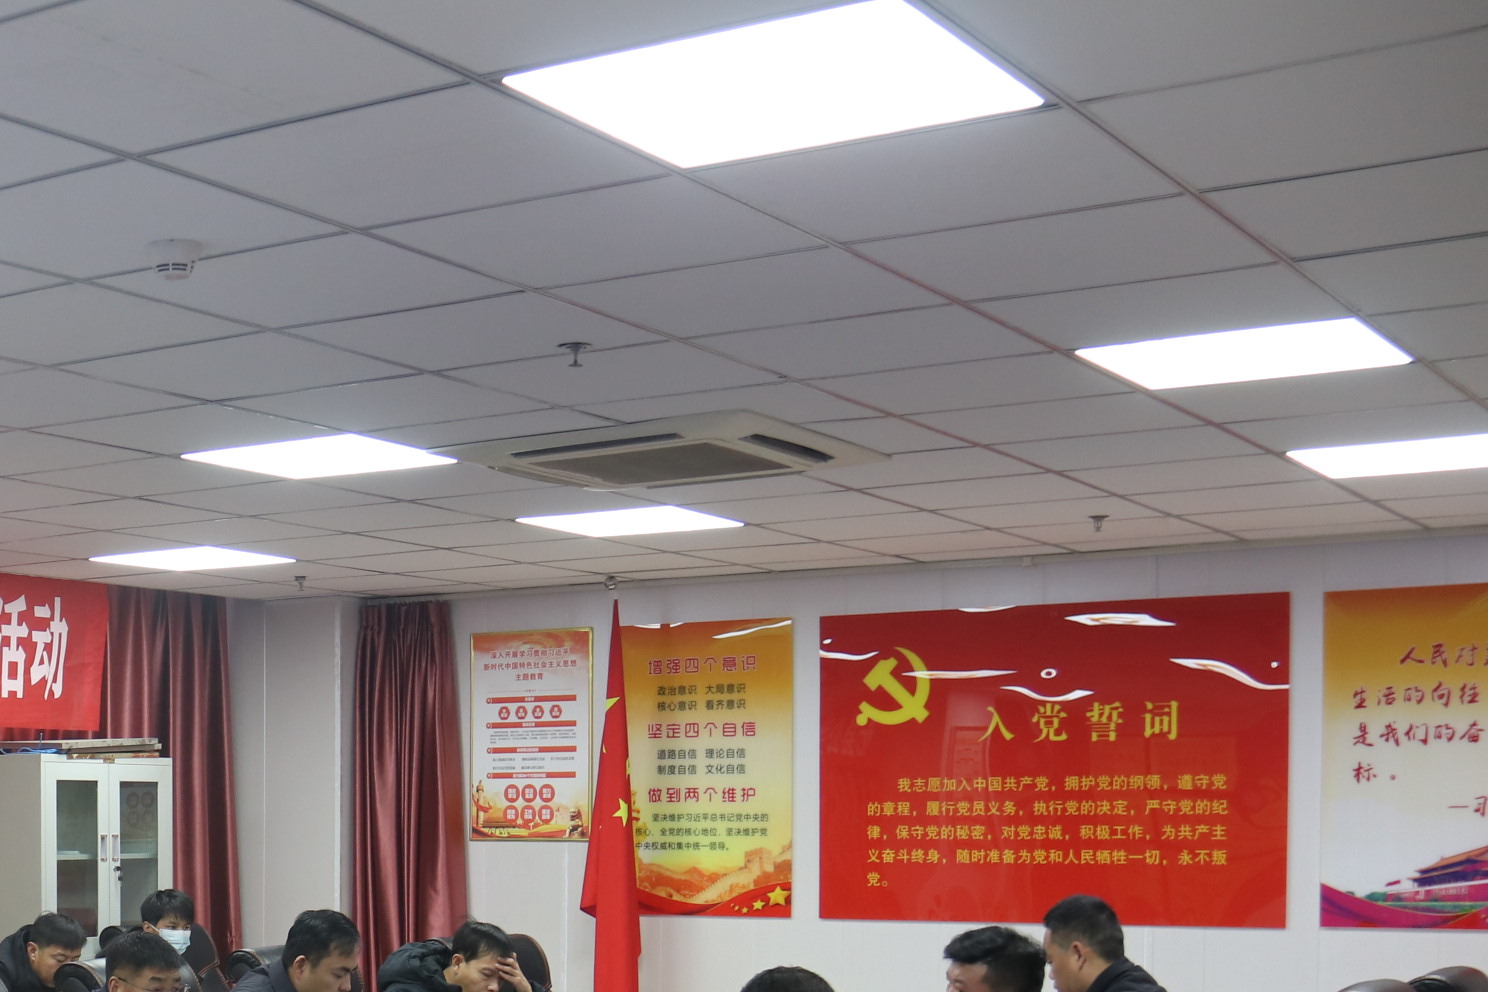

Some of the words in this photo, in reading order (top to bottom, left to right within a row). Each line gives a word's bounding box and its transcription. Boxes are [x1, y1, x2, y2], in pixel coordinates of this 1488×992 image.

[1399, 643, 1488, 668] 人民对
[647, 655, 757, 675] 增强四个意识
[656, 684, 697, 696] 政治意识
[704, 683, 746, 695] 大局意识
[1352, 681, 1480, 709] 生活的向往
[656, 700, 697, 712] 核心意识
[704, 699, 746, 711] 看齐意识
[977, 699, 1180, 743] 入党誓词
[647, 721, 757, 739] 坚定四个自信
[1352, 720, 1485, 747] 是我们的奋
[656, 749, 697, 760] 道路自信
[704, 748, 746, 759] 理论自信
[656, 764, 697, 775] 制度自信
[704, 763, 746, 775] 文化自信
[897, 773, 1227, 793] 我志愿加入中国共产党，拥护党的纲领，遵守党
[647, 787, 756, 803] 做到两个维护
[867, 799, 1229, 817] 的章程，履行党员义务，执行党的决定，严守党的纪
[651, 813, 769, 823] 坚决维护习近平总书记党中央的
[867, 824, 1228, 840] 律，保守党的秘密，对党忠诚，积极工作，为共产主
[867, 849, 1228, 865] 义奋斗终身，随时准备为党和人民牺牲一切，永不叛
[867, 871, 888, 887] 党。
